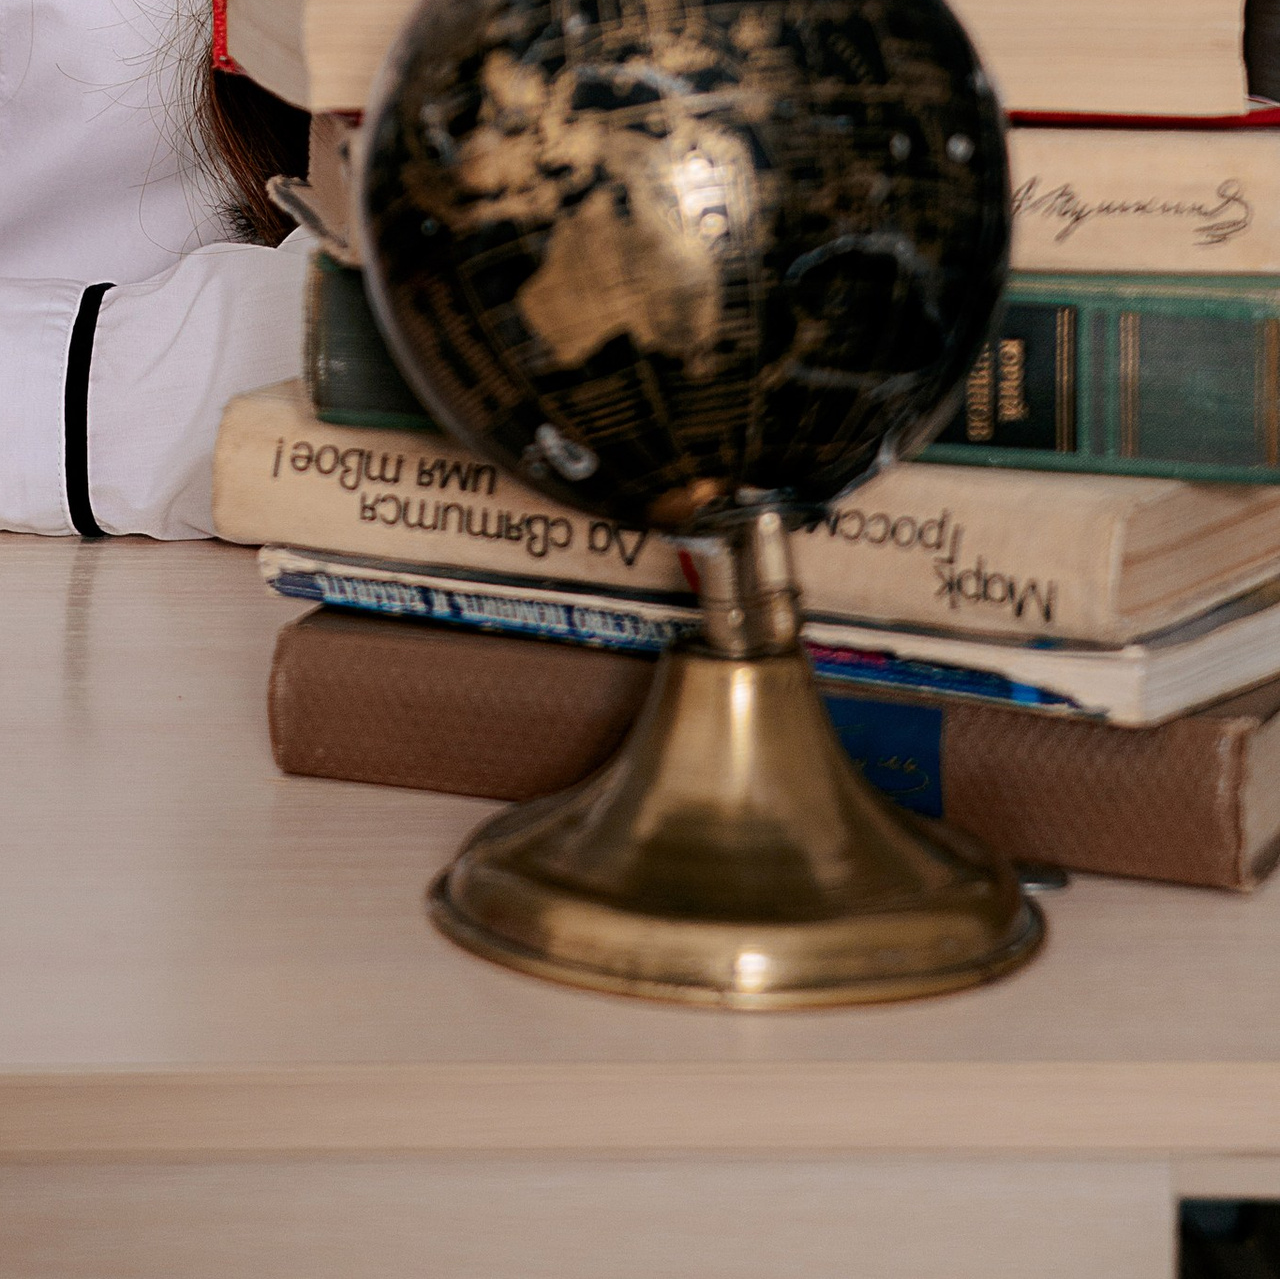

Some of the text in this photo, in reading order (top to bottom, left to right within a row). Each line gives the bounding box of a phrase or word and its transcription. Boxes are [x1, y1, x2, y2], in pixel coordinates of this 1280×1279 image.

[999, 339, 1029, 423] ЮРИЙ
[271, 438, 497, 497] имя твое!
[358, 489, 648, 567] Да святится
[934, 555, 1057, 623] Марк
